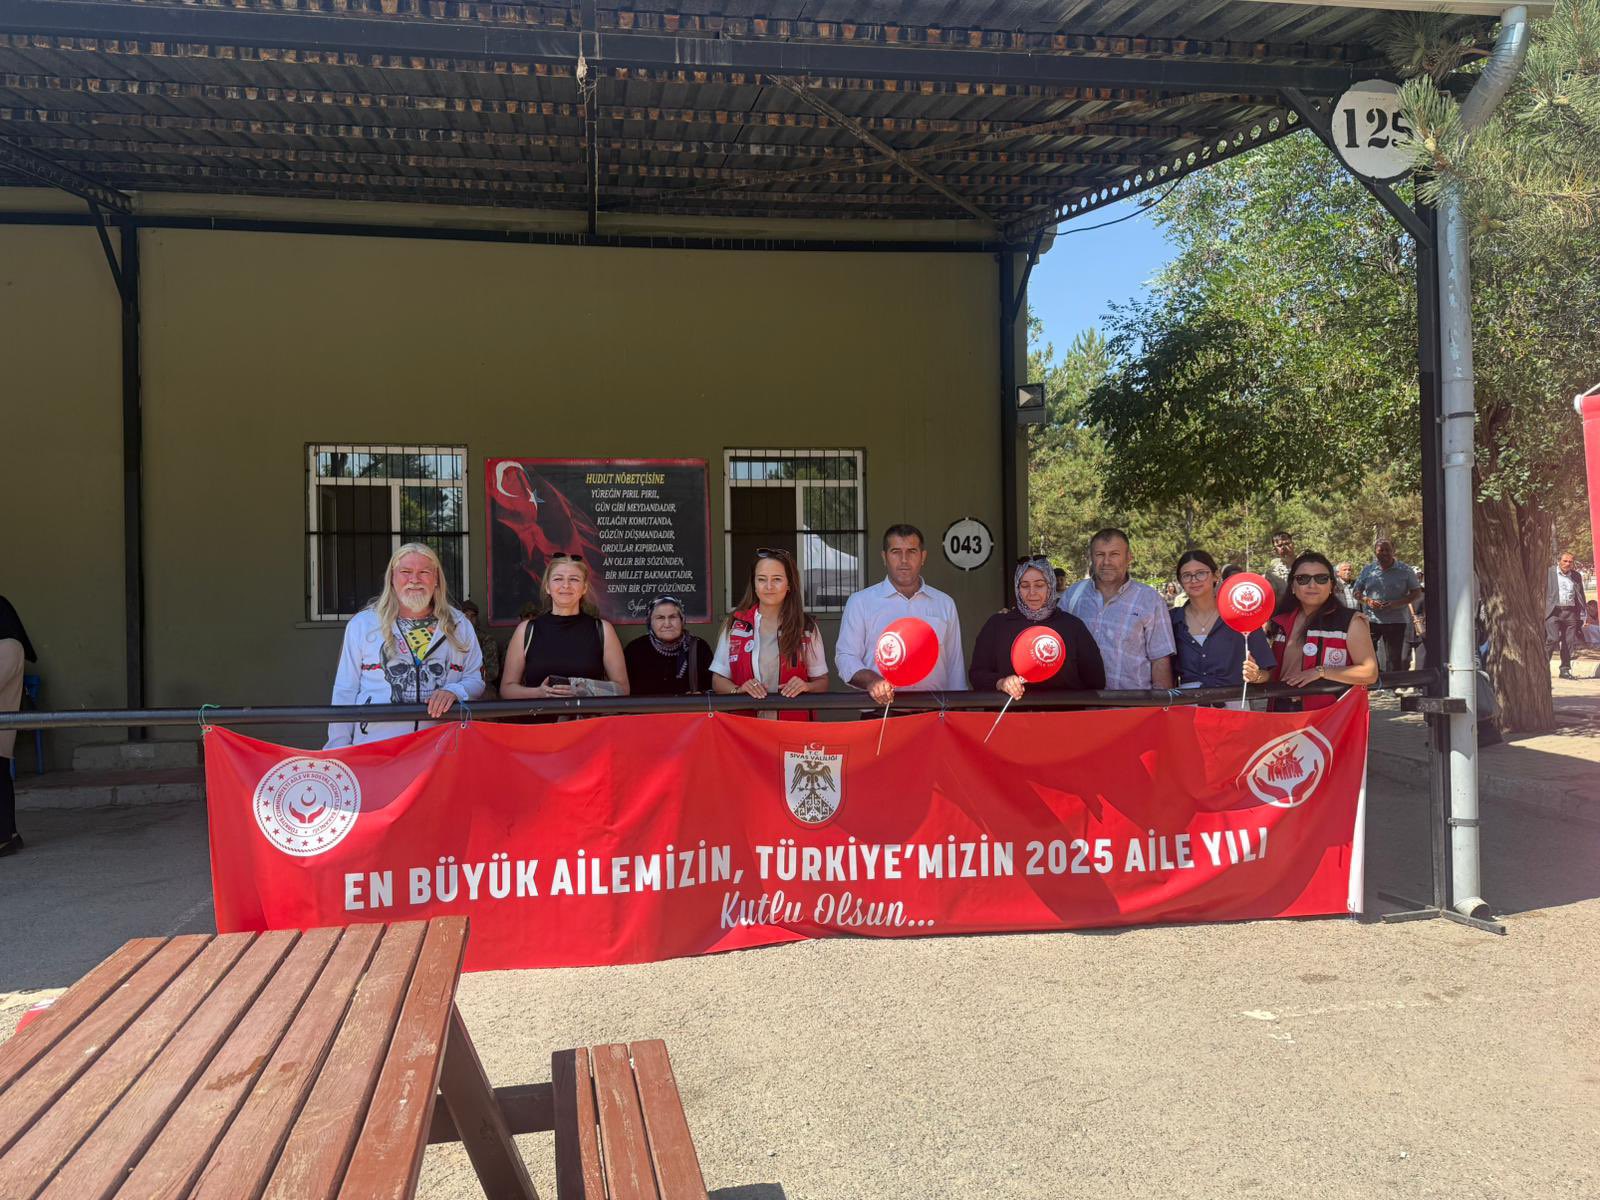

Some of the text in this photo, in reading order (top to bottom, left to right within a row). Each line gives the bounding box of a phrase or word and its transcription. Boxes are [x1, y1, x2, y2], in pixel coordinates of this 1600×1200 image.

[585, 471, 665, 486] HUDUT NÖBETÇİSİNE
[595, 501, 611, 512] GÜN
[601, 543, 634, 553] ORDULAR
[950, 535, 982, 554] 043
[344, 870, 393, 911] EN
[409, 852, 539, 905] BÜYÜK
[549, 839, 744, 896] AİLEMİZİN,
[1025, 838, 1114, 875] 2025
[1124, 828, 1196, 873] AİLE
[1200, 826, 1269, 867] YILI
[720, 890, 935, 929] Kutlu Olsun...
